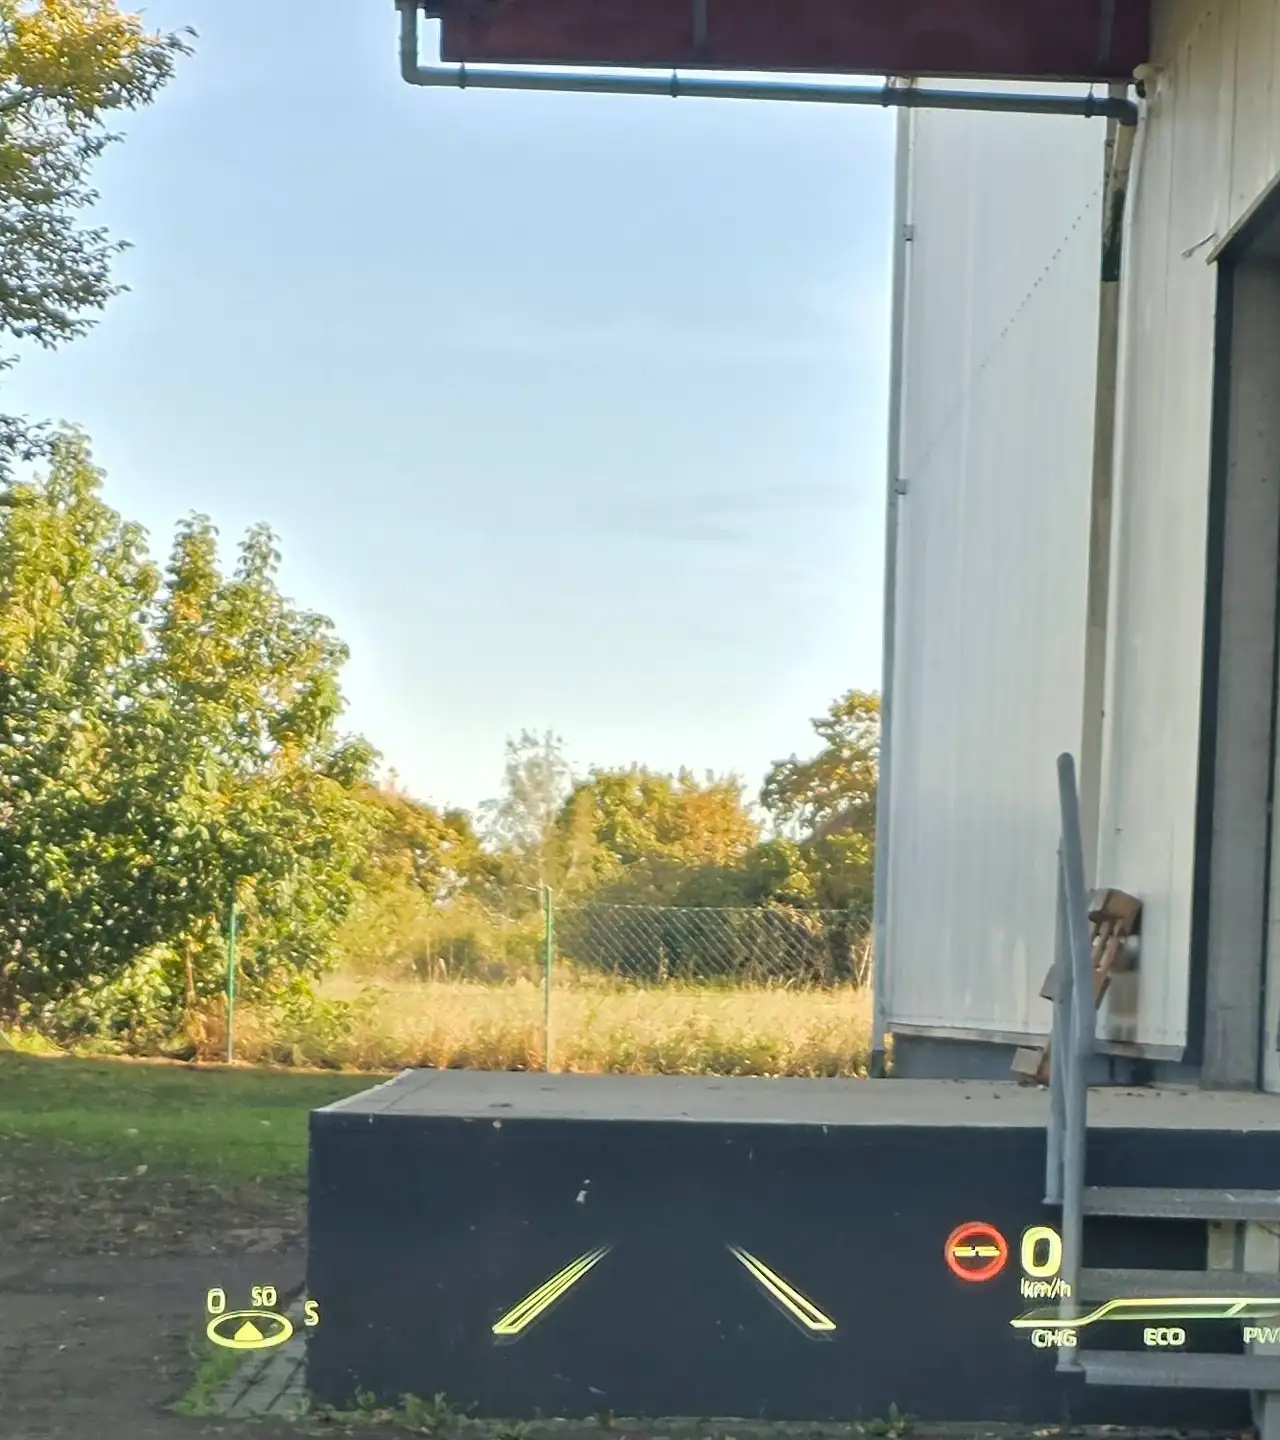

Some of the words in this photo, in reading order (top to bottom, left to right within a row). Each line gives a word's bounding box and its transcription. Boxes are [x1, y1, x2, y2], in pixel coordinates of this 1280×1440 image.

[1021, 1226, 1062, 1277] 0
[1021, 1277, 1071, 1298] km/h
[304, 1300, 320, 1326] S
[1031, 1329, 1077, 1348] CHG
[1144, 1327, 1186, 1346] ECO
